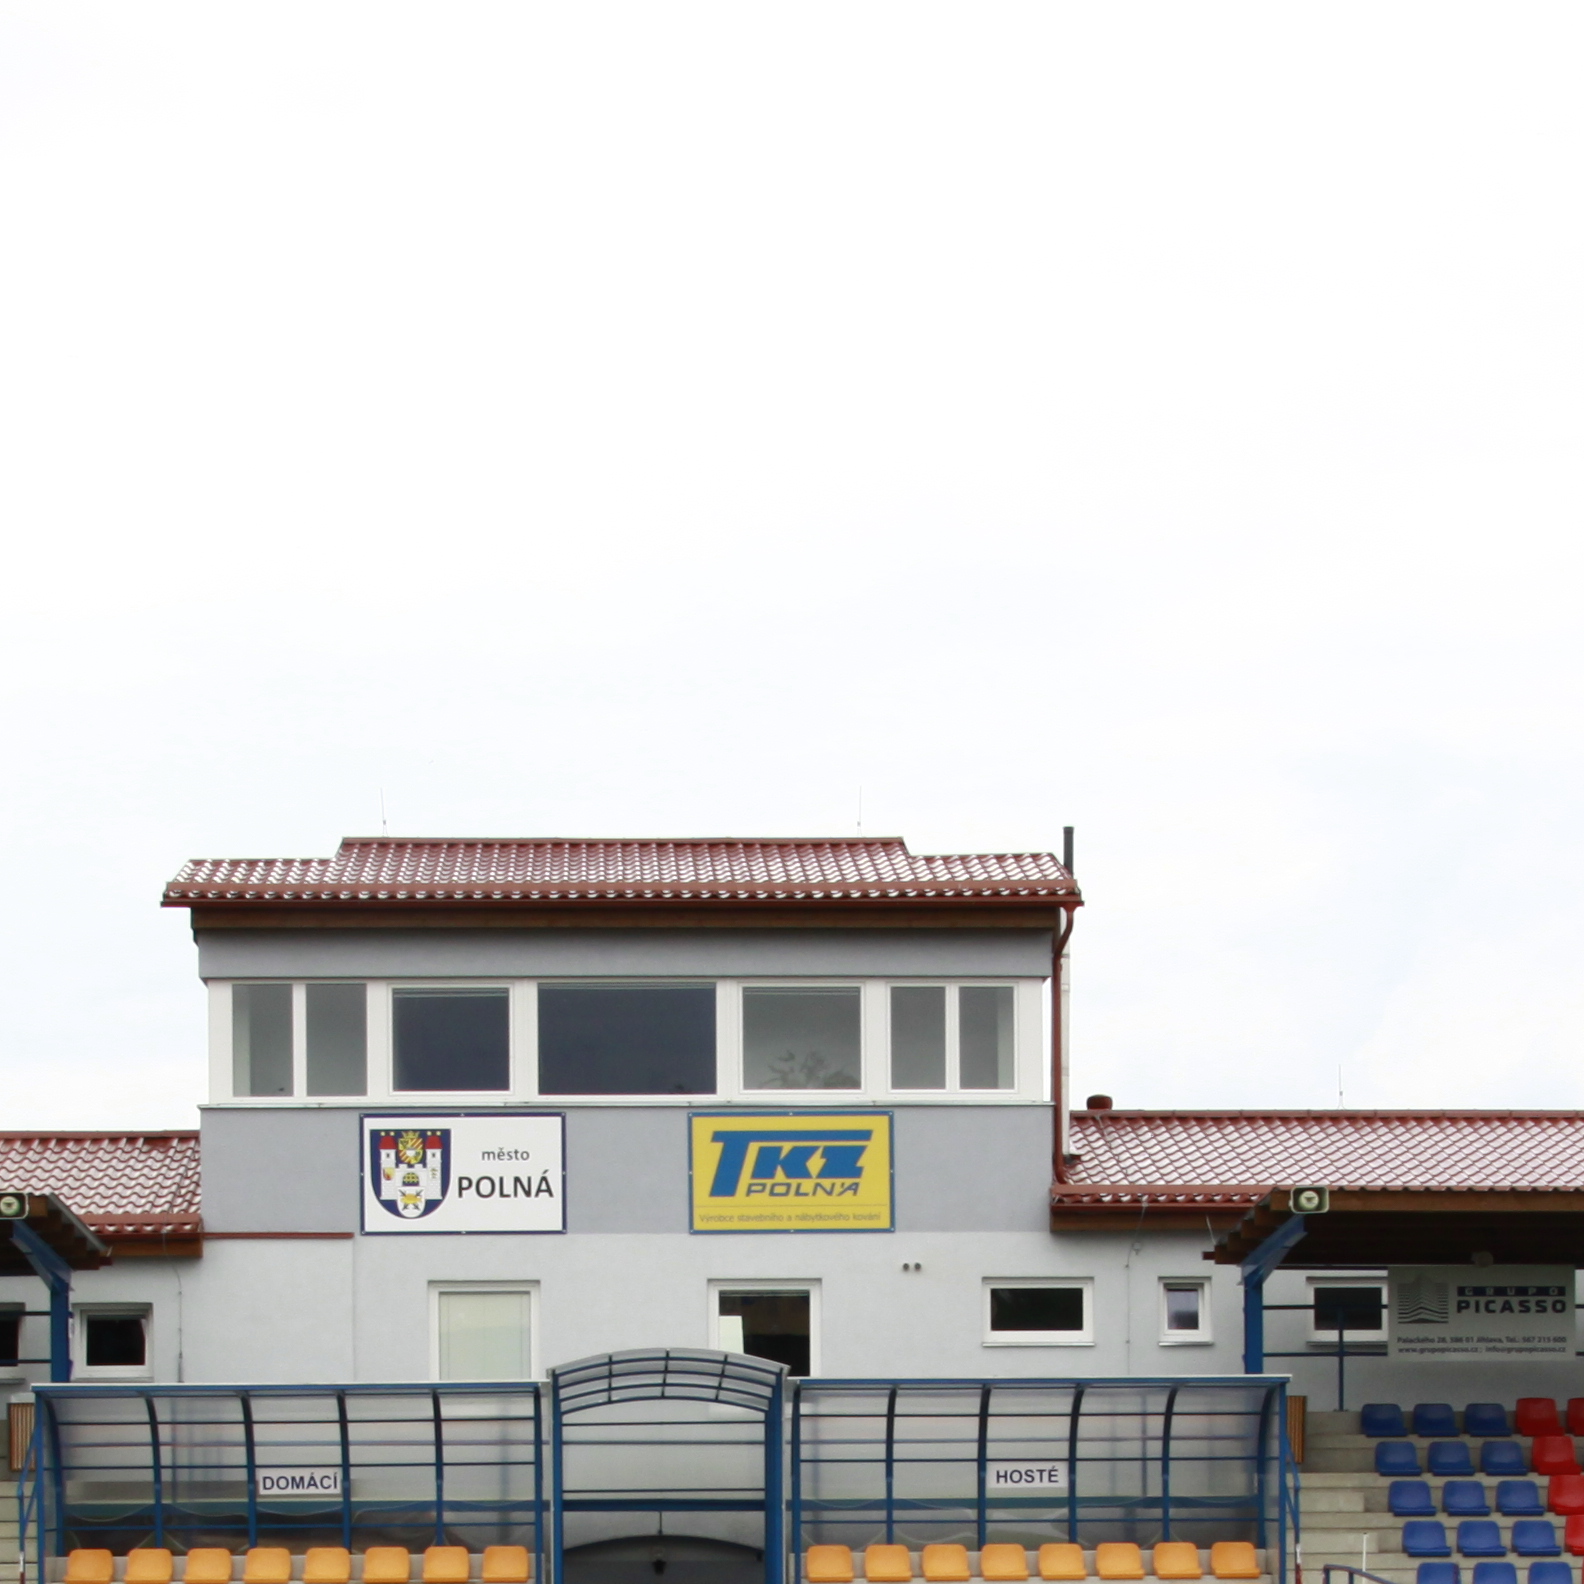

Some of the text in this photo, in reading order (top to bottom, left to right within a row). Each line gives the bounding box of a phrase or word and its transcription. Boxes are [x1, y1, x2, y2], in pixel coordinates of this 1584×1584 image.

[482, 1147, 530, 1161] město
[709, 1130, 873, 1197] TKZ
[458, 1169, 554, 1198] POLNÁ
[737, 1211, 784, 1222] stavebního
[795, 1211, 850, 1223] nábytkového
[1464, 1287, 1558, 1296] GRUPO
[1457, 1300, 1566, 1313] PICASSO
[262, 1472, 338, 1490] DOMÁCÍ
[996, 1465, 1059, 1484] HOSTÉ
